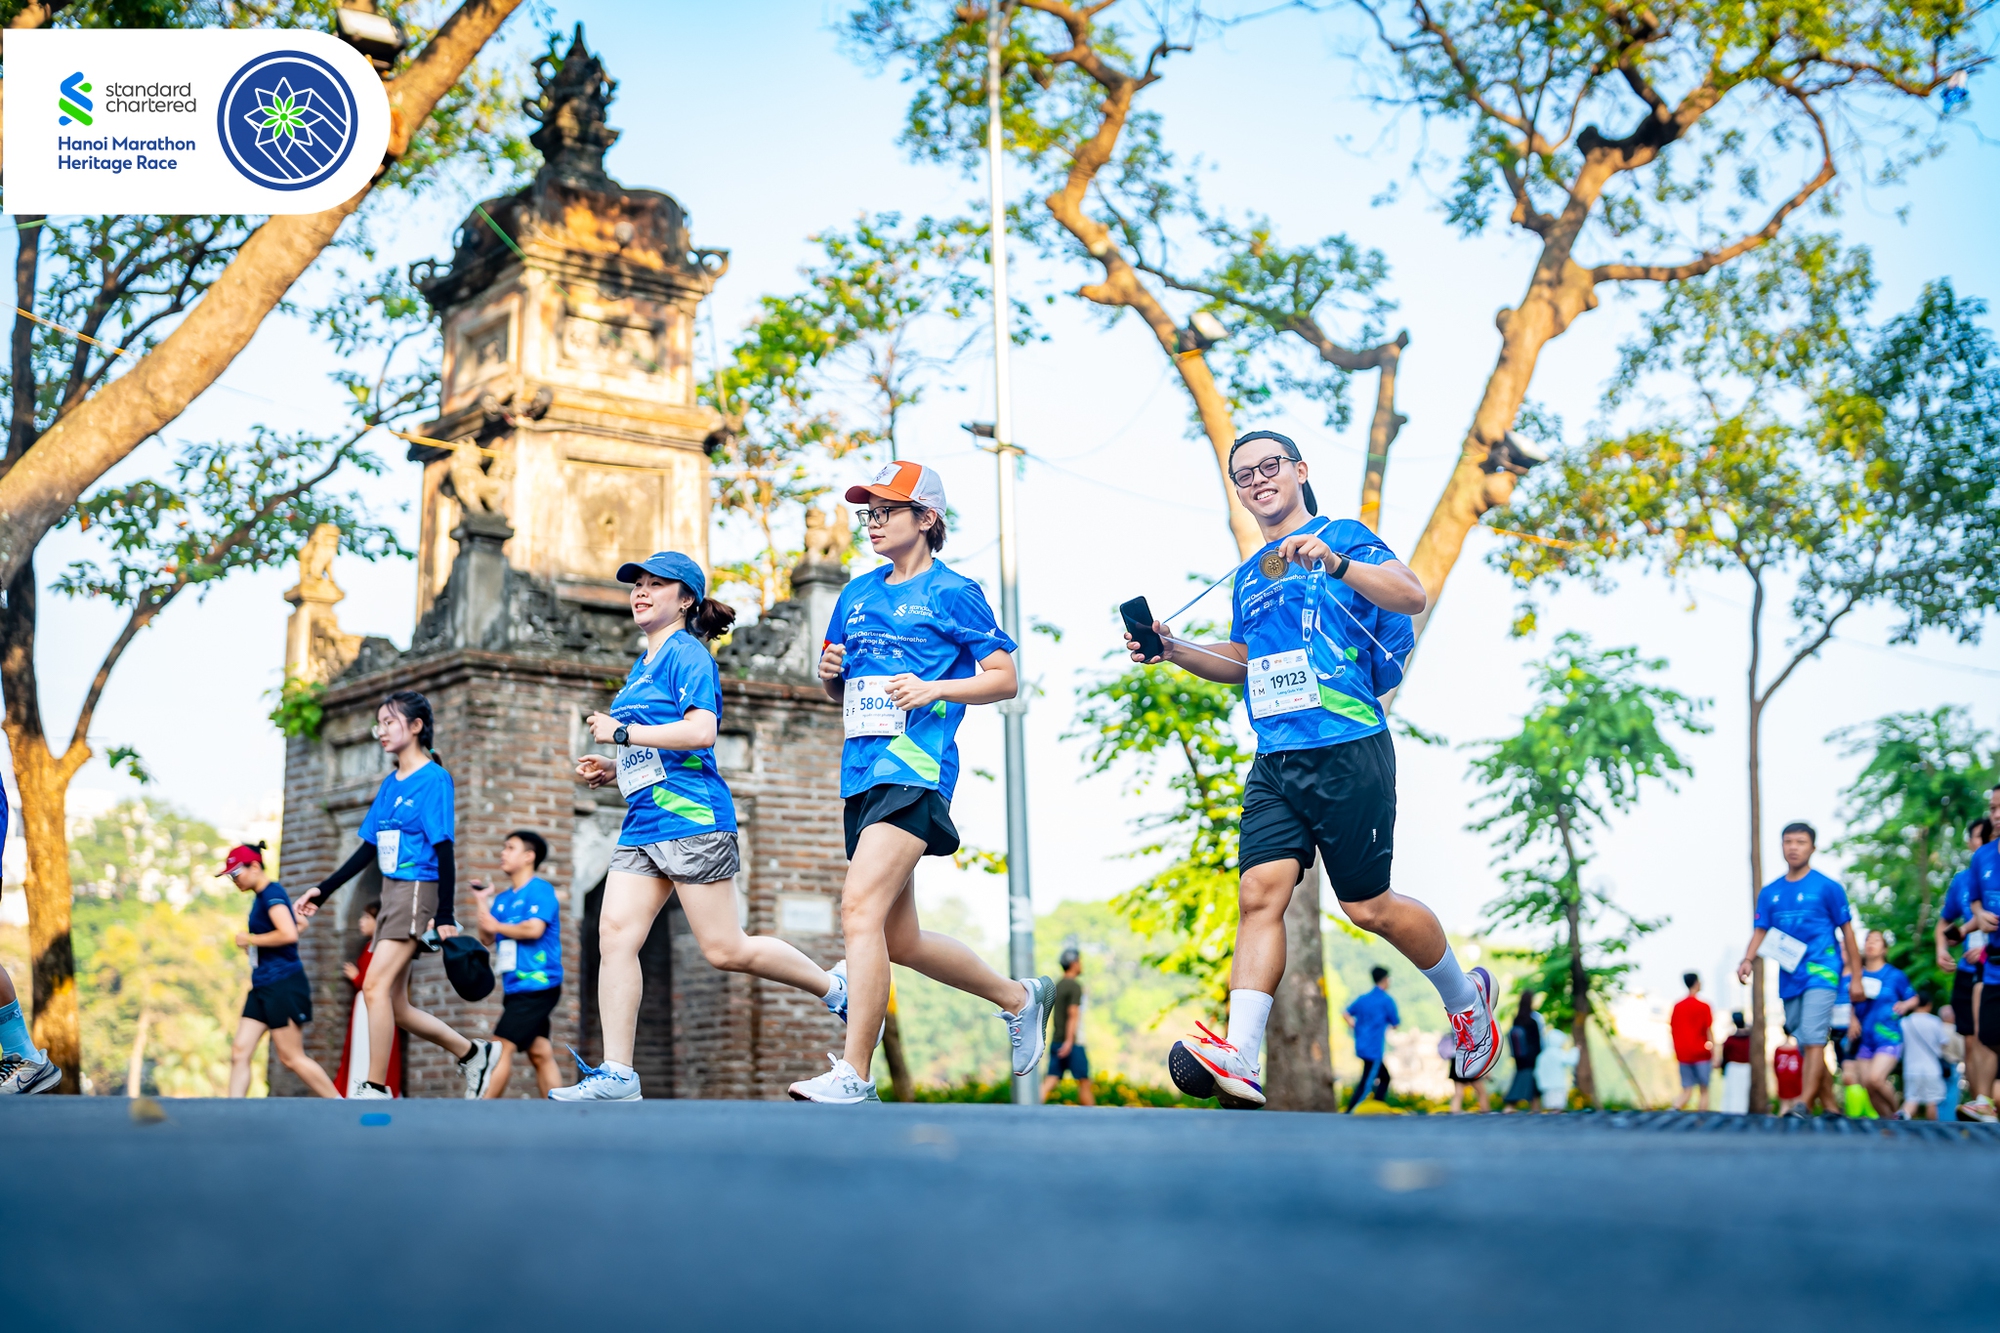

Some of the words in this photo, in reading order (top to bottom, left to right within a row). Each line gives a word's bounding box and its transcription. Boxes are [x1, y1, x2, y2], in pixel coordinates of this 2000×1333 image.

[897, 635, 928, 643] Marathon
[1270, 671, 1307, 689] 19123
[860, 697, 900, 711] 5804
[621, 747, 654, 771] 56056
